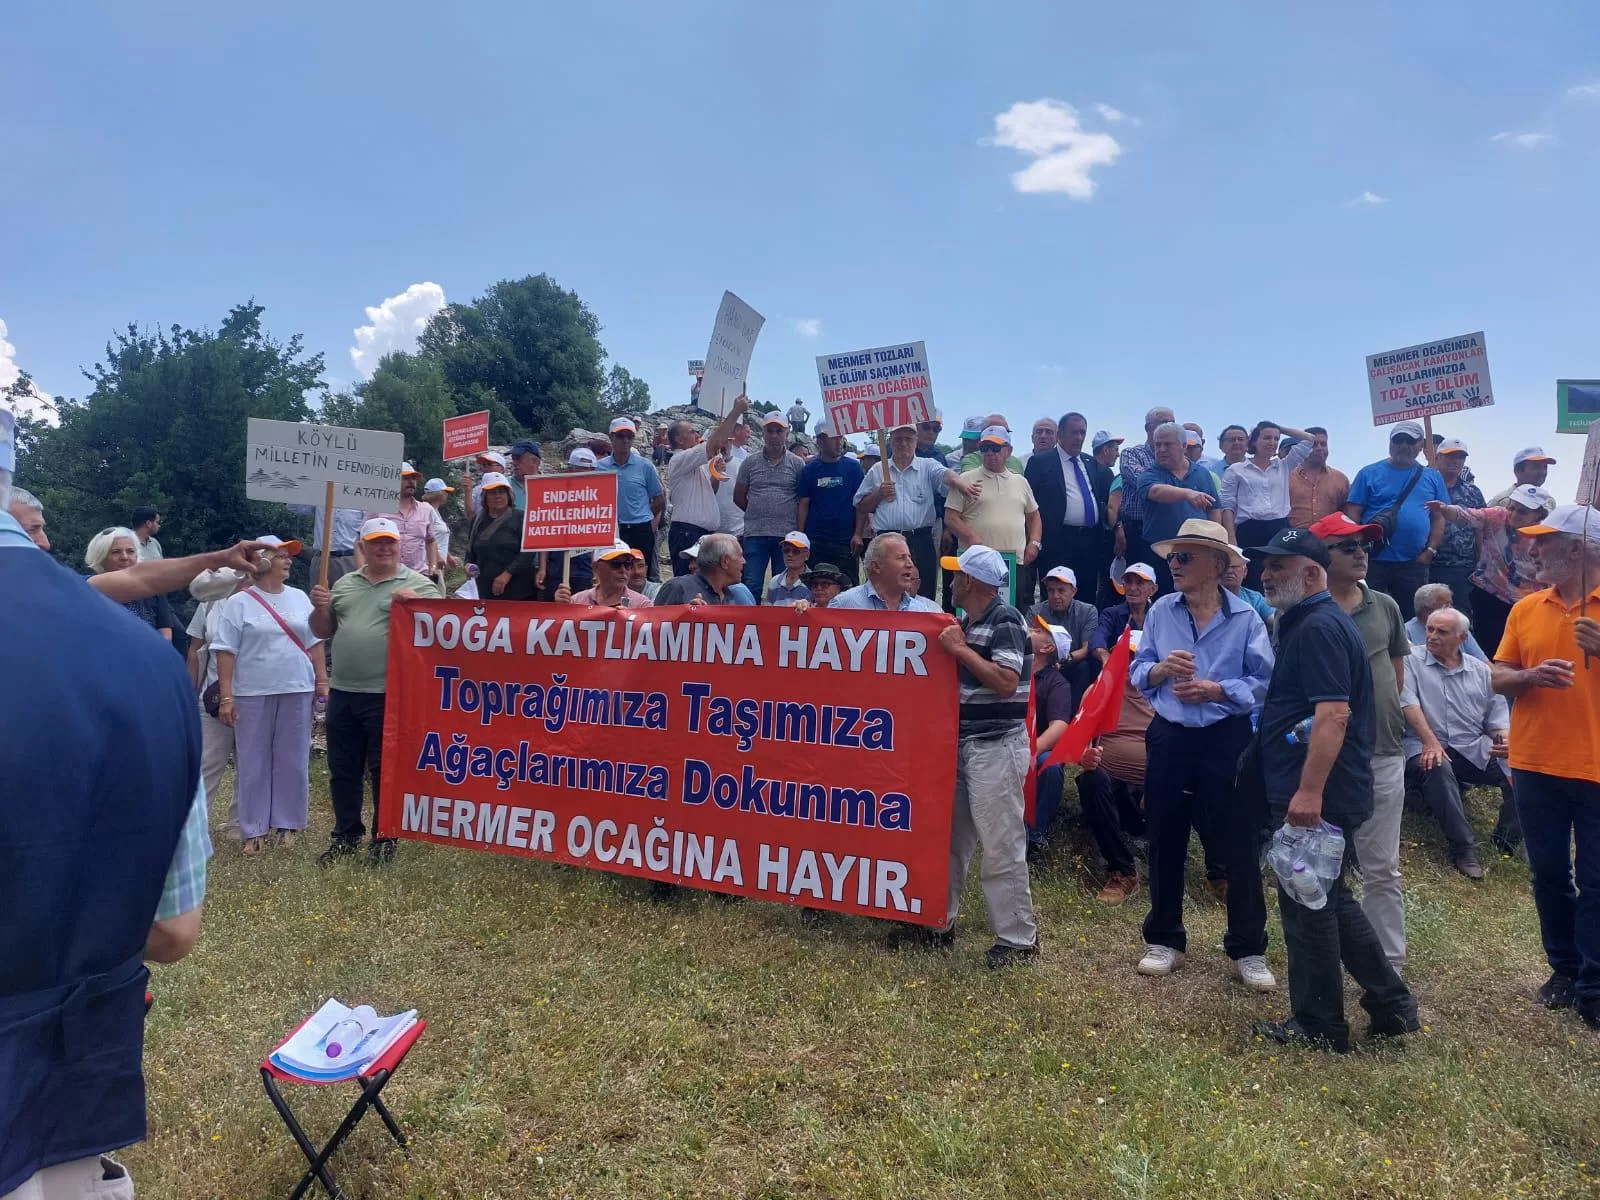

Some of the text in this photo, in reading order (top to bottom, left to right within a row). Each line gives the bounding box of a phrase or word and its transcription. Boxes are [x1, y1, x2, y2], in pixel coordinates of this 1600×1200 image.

[828, 346, 914, 370] MERMER TOZLARI
[1373, 338, 1477, 368] MERMER OCAĞINDA
[1424, 347, 1483, 366] KAMYONLAR
[822, 361, 925, 387] İLE ÖLÜM SAÇMAYIN.
[1388, 362, 1466, 385] YOLLARIMIZDA
[824, 375, 928, 403] MERMER OCAĞINA
[1380, 372, 1479, 402] TOZ VE ÖLÜM
[1405, 390, 1455, 408] SAÇACAK
[833, 394, 927, 436] HAYIR
[1375, 410, 1418, 425] MERMER
[298, 429, 357, 451] KÖYLÜ
[255, 446, 401, 480] MİLLETİN EFENDİSİDİR
[543, 485, 598, 504] ENDEMİK
[529, 504, 613, 522] BİTKİLERİMİZİ
[528, 521, 611, 537] KATLETTİRMEYİZ!
[413, 604, 929, 677] DOĞA KATLİAMINA HAYIR
[434, 665, 895, 752] Toprağımıza Taşımıza
[416, 731, 912, 832] Ağaçlarımıza Dokunma
[401, 793, 923, 914] MERMER OCAĞINA HAYIR.
